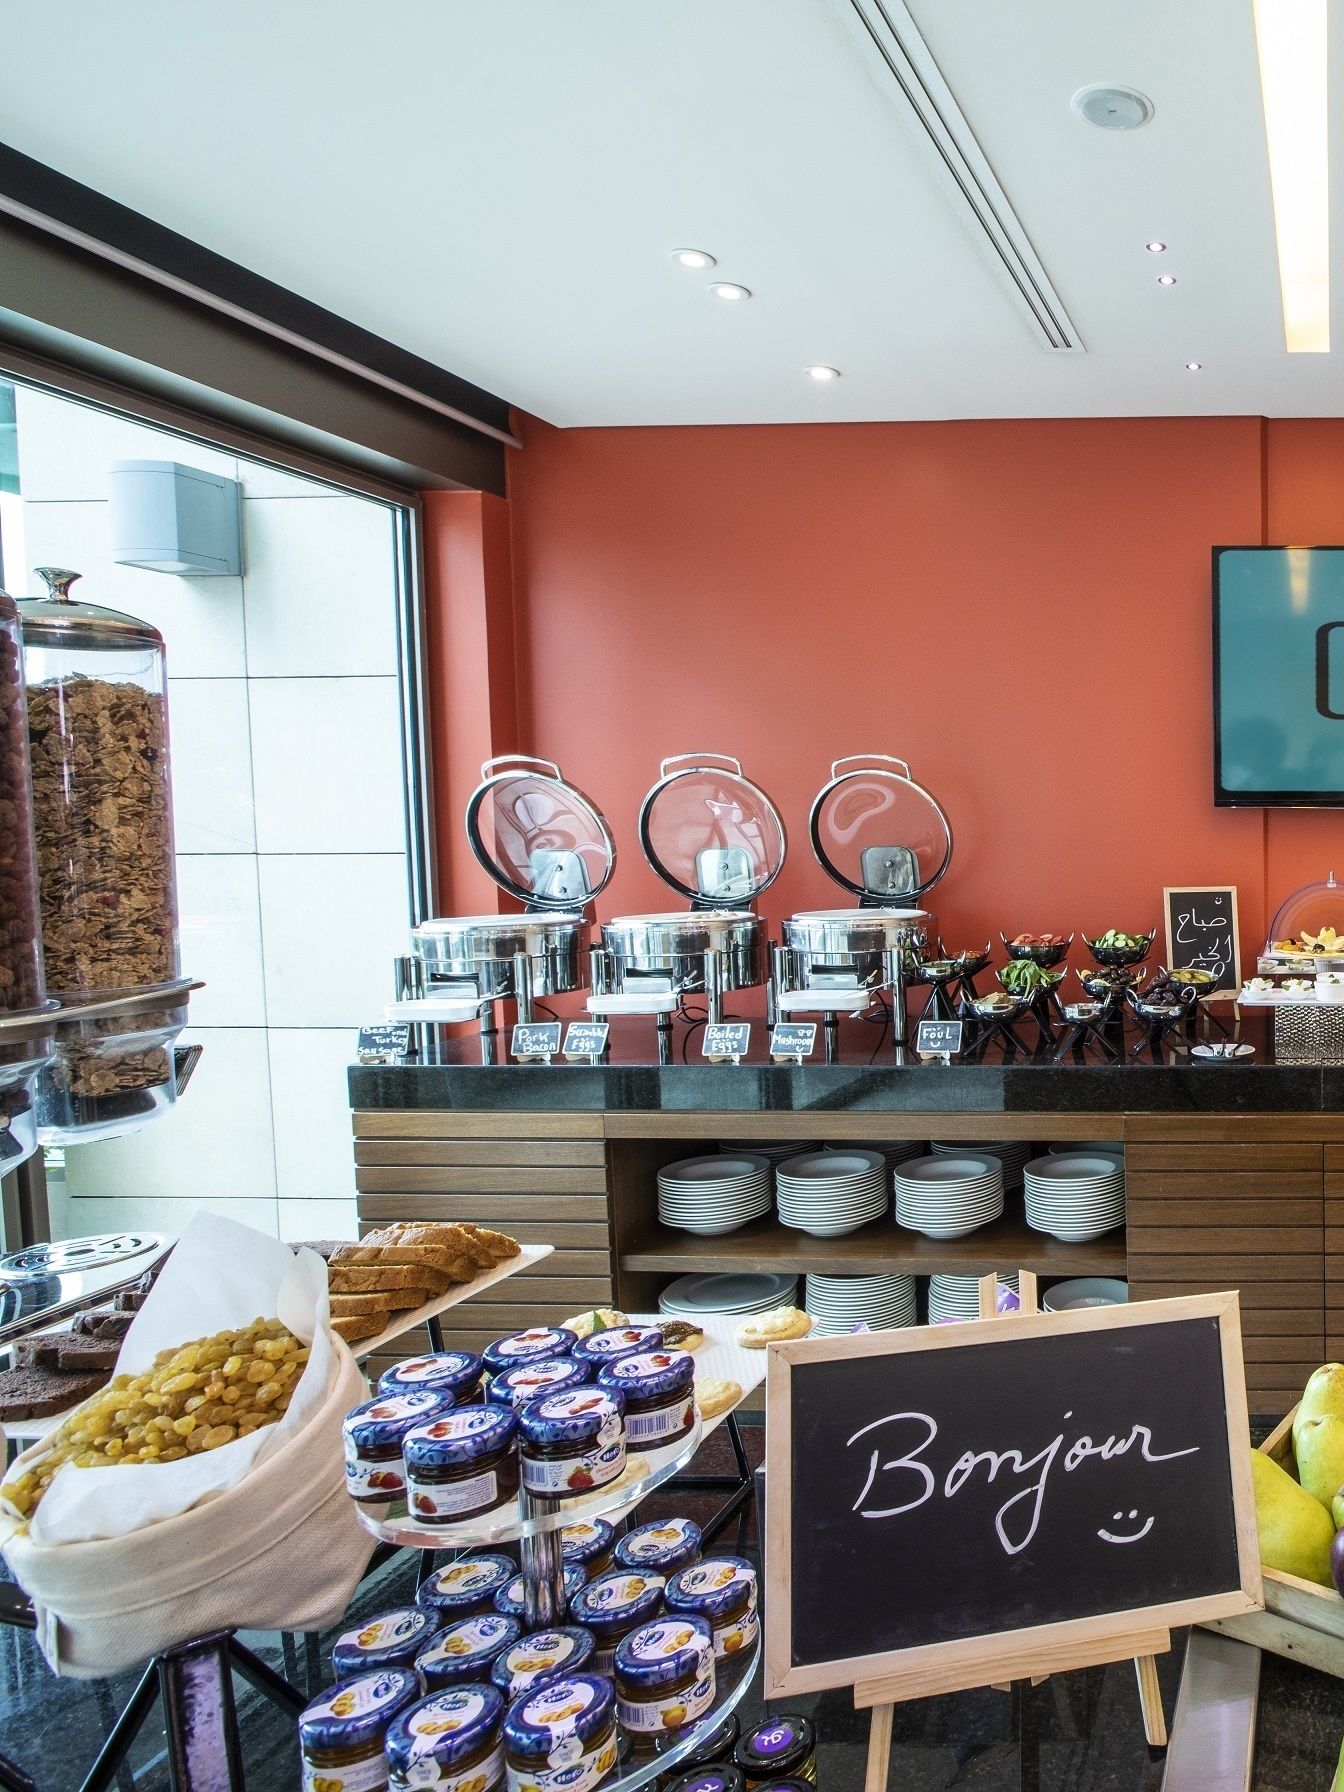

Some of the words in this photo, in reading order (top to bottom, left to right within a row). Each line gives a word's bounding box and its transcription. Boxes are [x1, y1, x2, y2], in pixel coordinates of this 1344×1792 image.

[1177, 907, 1228, 944] صباح
[1181, 934, 1232, 969] الخير
[708, 1025, 744, 1039] Boiled
[523, 1041, 556, 1054] Bacon
[571, 1038, 596, 1052] Eggs
[711, 1039, 739, 1053] Eggs
[602, 1446, 621, 1461] Hero
[846, 1411, 1201, 1555] Bonjour
[534, 1642, 559, 1651] Hero
[555, 1768, 583, 1784] Hero
